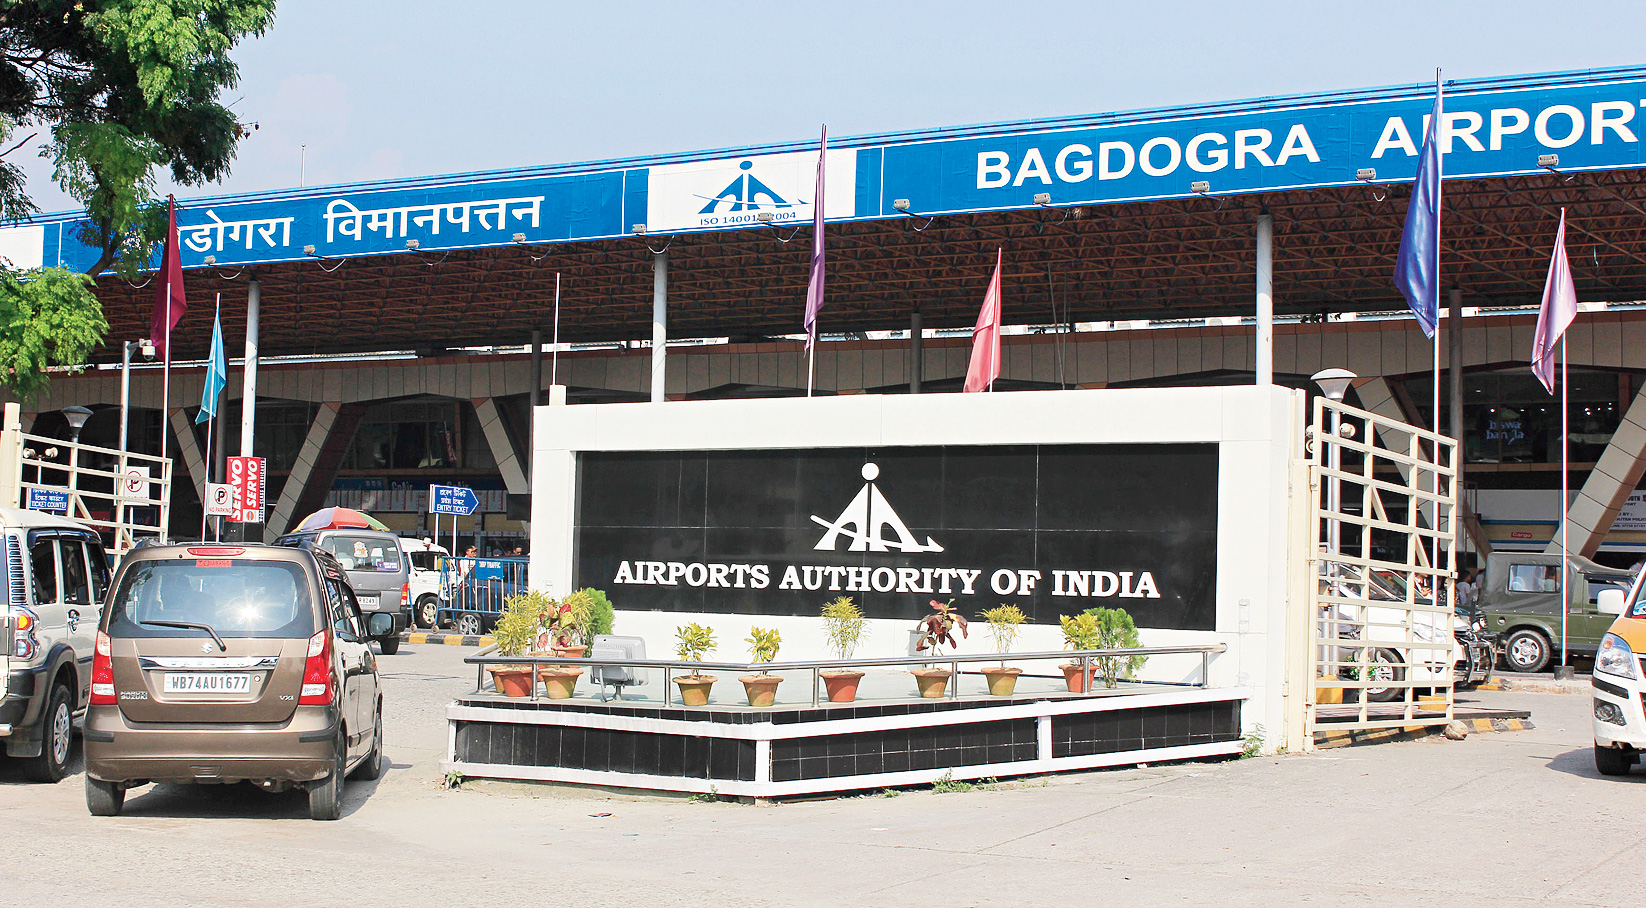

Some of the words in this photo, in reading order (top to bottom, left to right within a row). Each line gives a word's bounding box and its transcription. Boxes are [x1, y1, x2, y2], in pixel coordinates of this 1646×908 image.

[976, 124, 1320, 189] BAGDOGRA
[1370, 99, 1646, 159] ARPOR
[323, 196, 545, 243] विमानपत्तन
[700, 217, 719, 226] ISO
[1488, 419, 1522, 430] bswa
[231, 459, 243, 521] SERVO
[246, 460, 258, 508] SERVO
[437, 504, 452, 512] ENTRY
[453, 505, 469, 514] TICKET
[613, 560, 770, 589] AIRPORTS
[778, 565, 981, 595] AUTHORITY
[990, 569, 1042, 596] OF
[1051, 570, 1161, 599] INDIA
[172, 676, 248, 689] WB74AU1677
